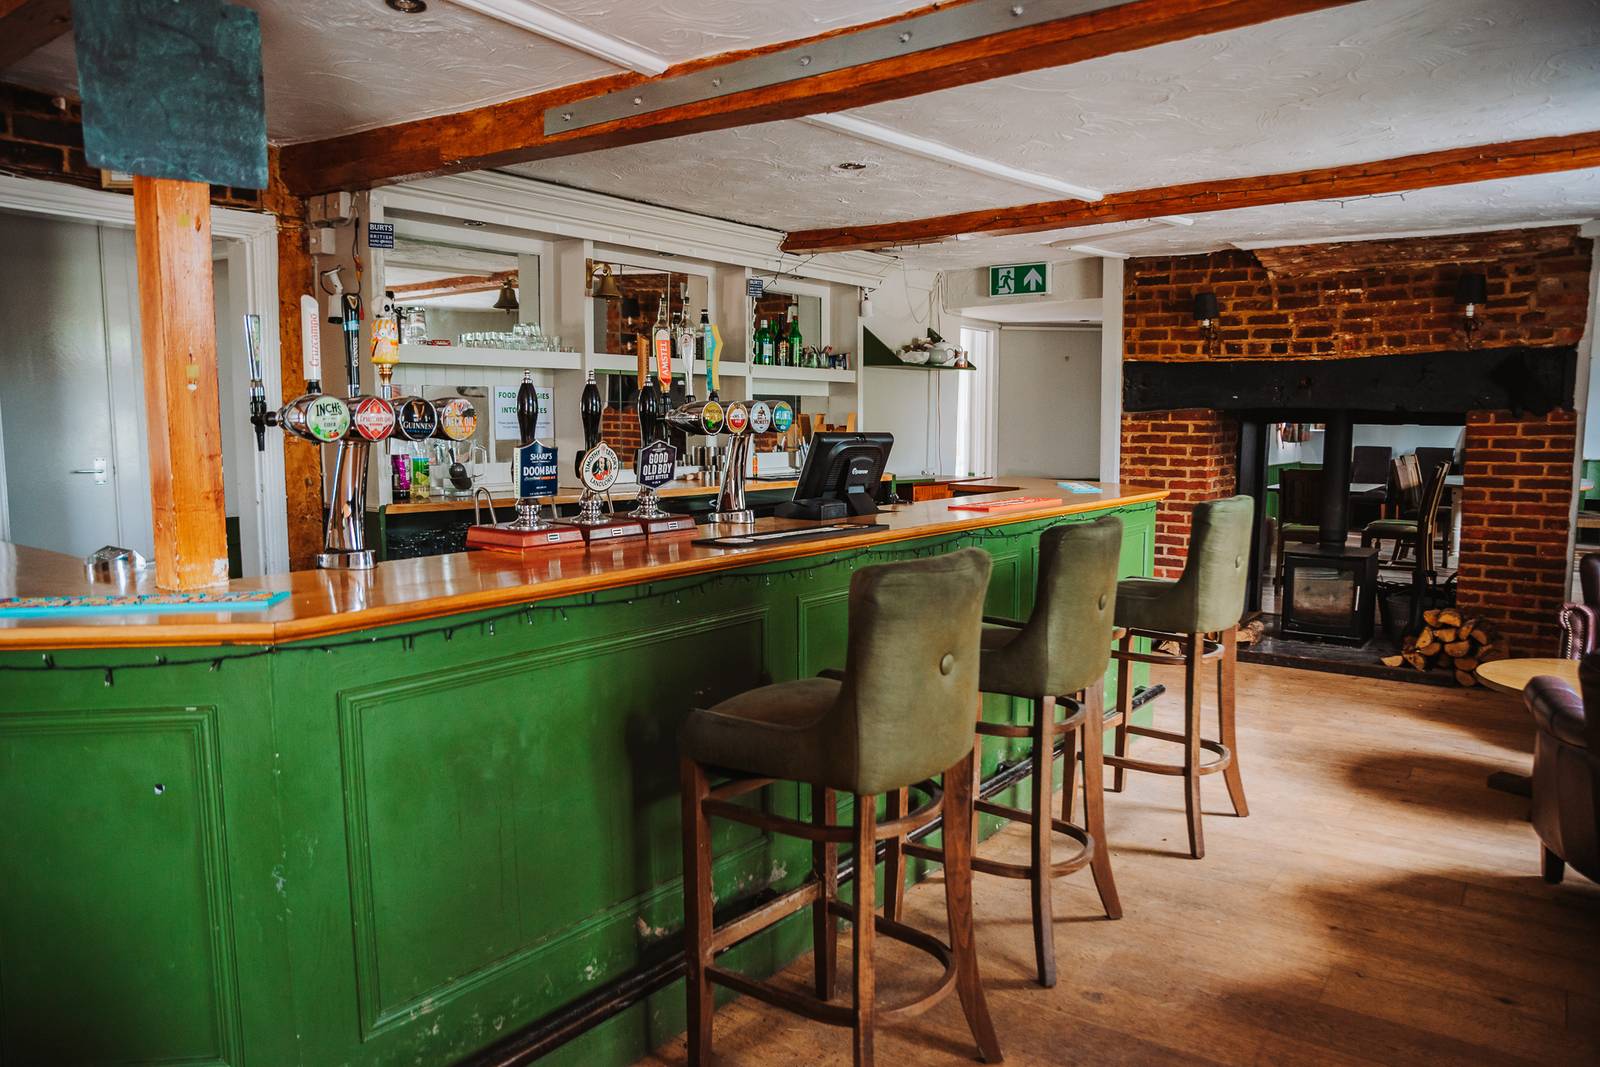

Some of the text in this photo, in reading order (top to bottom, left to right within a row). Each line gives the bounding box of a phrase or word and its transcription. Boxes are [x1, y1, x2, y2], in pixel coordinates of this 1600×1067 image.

[369, 223, 393, 231] BURTS
[660, 340, 669, 376] AMSTEL
[498, 391, 517, 399] FOOD
[402, 421, 434, 430] GUINNESS
[530, 453, 553, 461] SHARP'S
[584, 450, 601, 473] TIMOTHY
[649, 452, 669, 464] GOOD
[523, 466, 545, 477] DOOM
[642, 462, 673, 476] OLD BOY
[590, 474, 614, 487] LANDLORD
